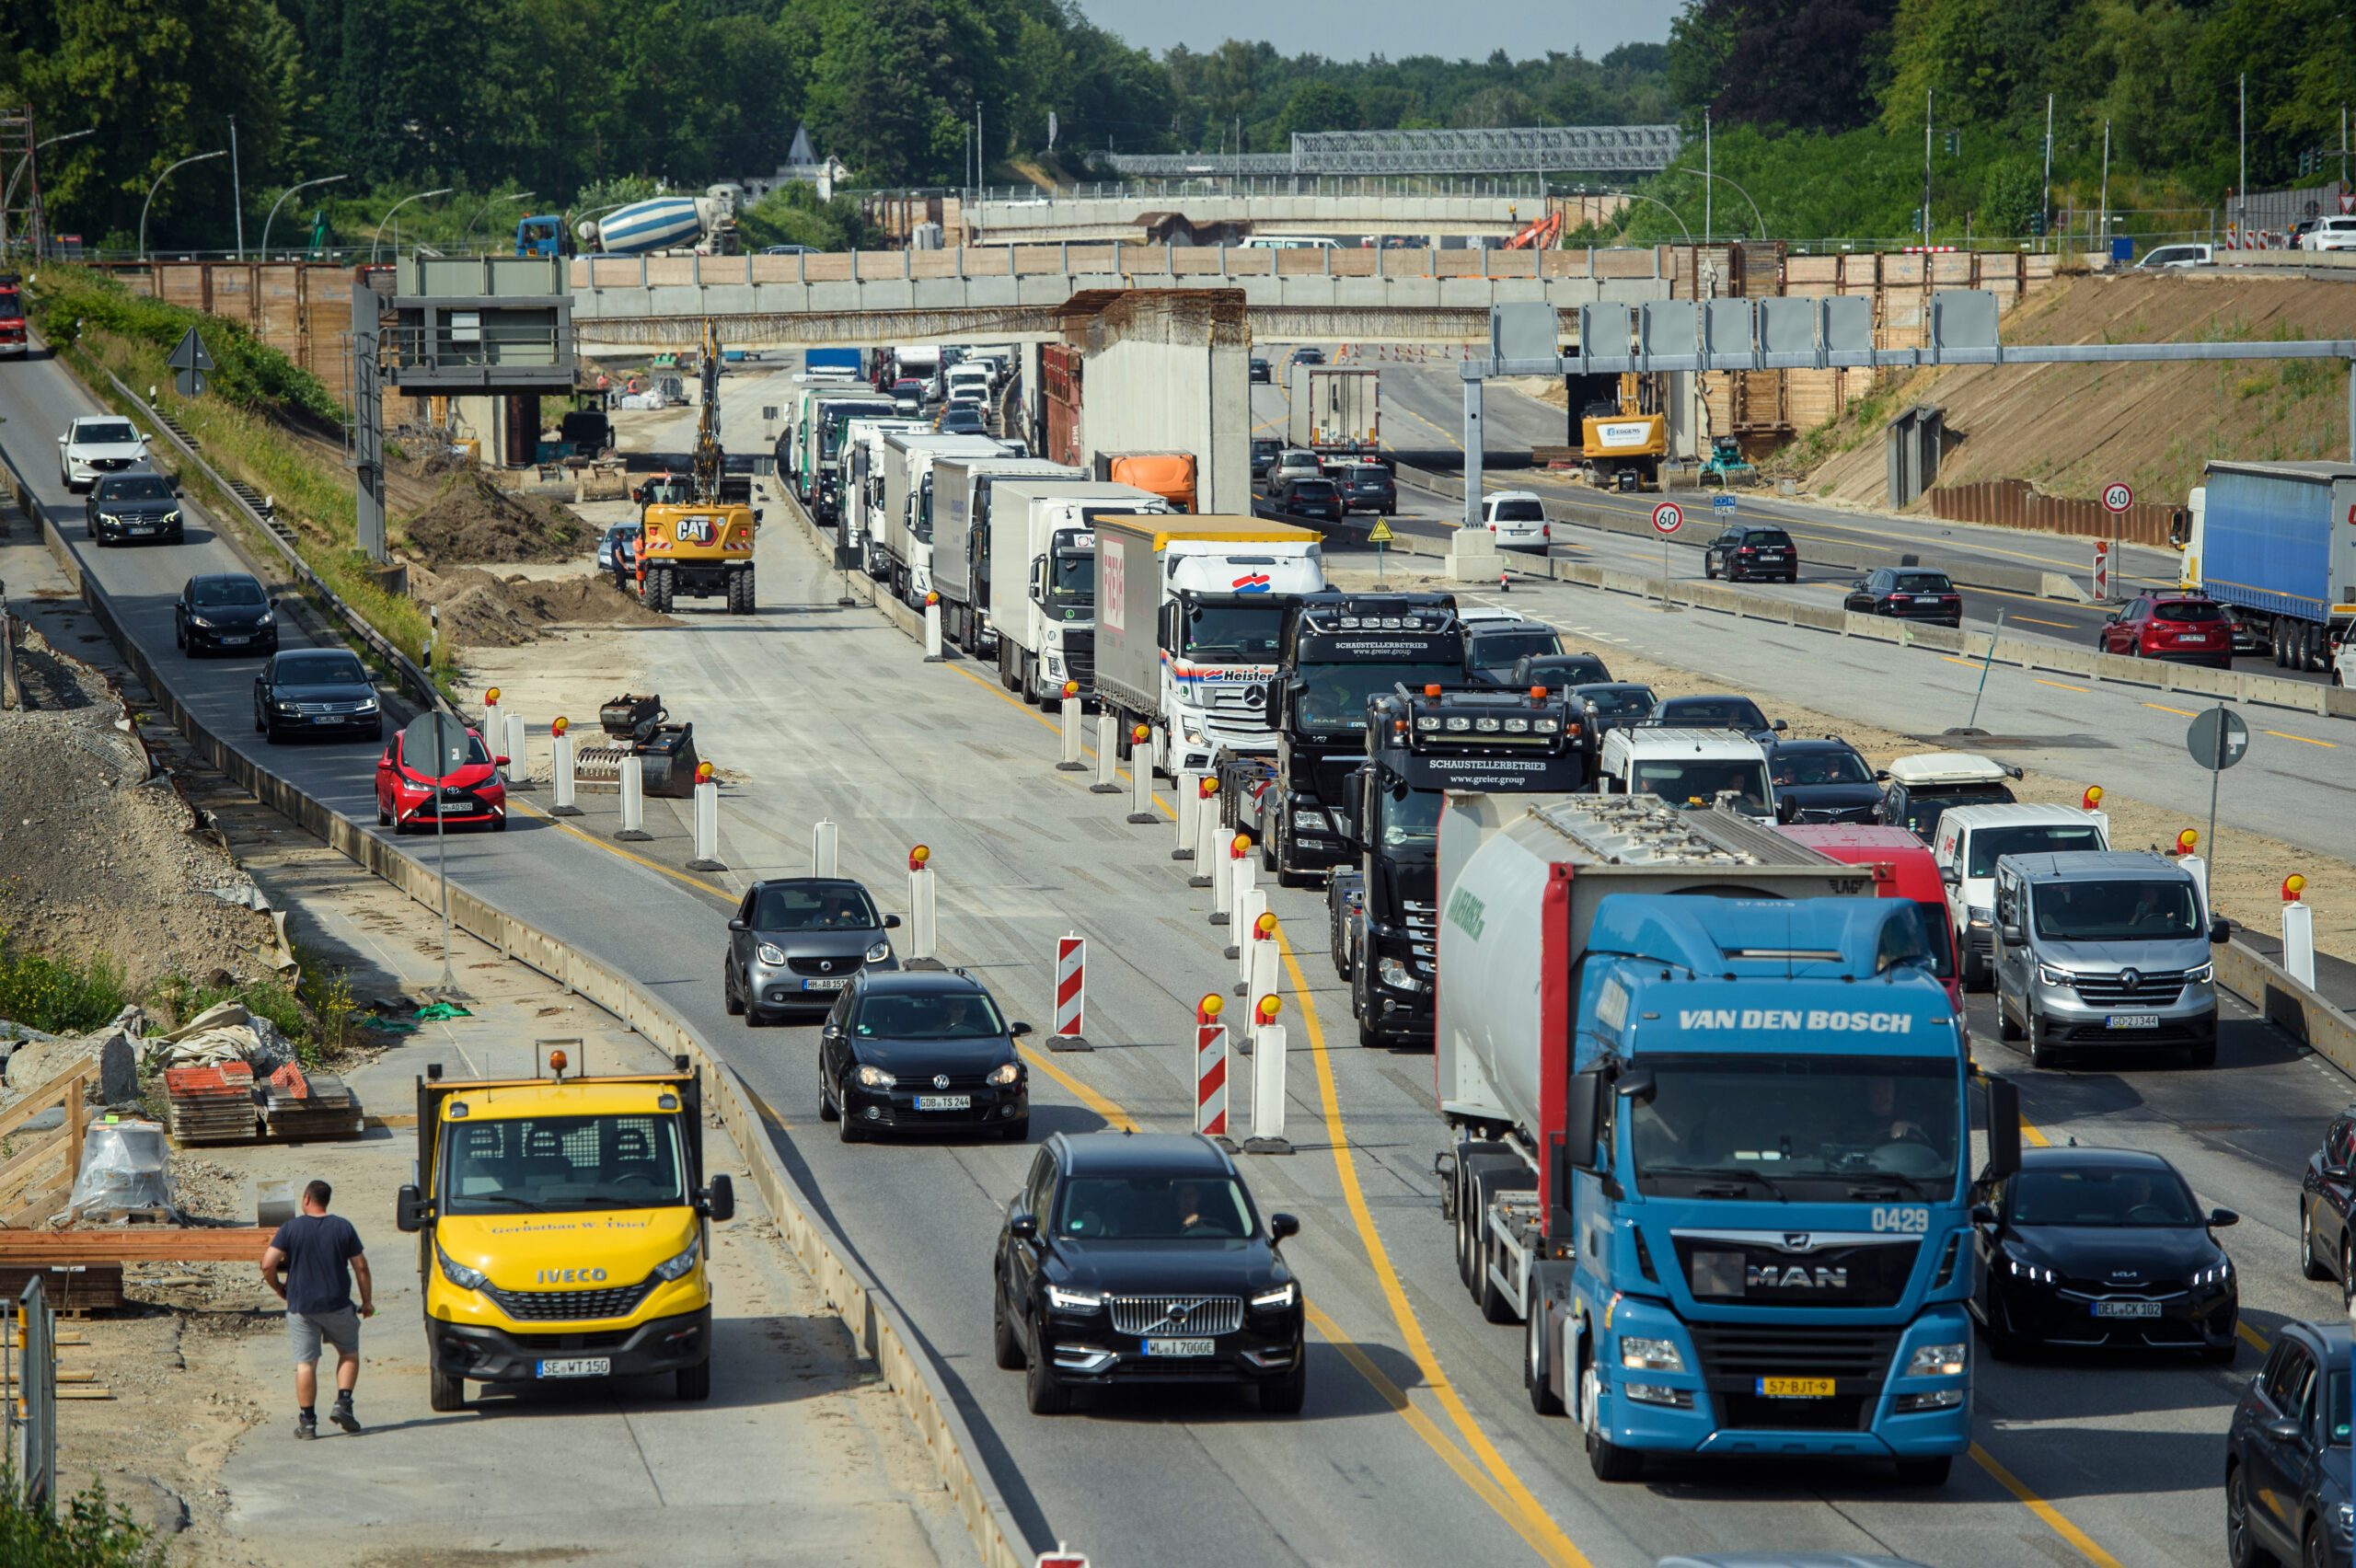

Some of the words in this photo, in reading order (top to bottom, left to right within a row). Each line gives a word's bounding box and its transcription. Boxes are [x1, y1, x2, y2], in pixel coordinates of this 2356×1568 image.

[2108, 490, 2127, 505] 60
[1658, 511, 1677, 525] 60
[676, 521, 709, 541] CAT
[1429, 759, 1546, 771] SCHAUSTELLERBETRIEB
[1449, 775, 1526, 786] www.greier.group
[807, 980, 817, 988] HH
[822, 980, 831, 988] AB
[1680, 1009, 1737, 1030] VAN
[1741, 1009, 1802, 1030] DEN
[1806, 1010, 1912, 1034] BOSCH
[920, 1098, 936, 1108] GDB
[942, 1098, 953, 1107] TS
[954, 1097, 969, 1107] 244
[604, 1221, 646, 1229] Thiel
[1871, 1207, 1929, 1233] 0429
[537, 1267, 607, 1284] IVECO
[1747, 1264, 1847, 1288] MAN
[2098, 1303, 2118, 1315] DEL
[2125, 1303, 2139, 1315] CK
[2142, 1303, 2160, 1315] 102
[1149, 1342, 1163, 1355] WL
[1171, 1342, 1178, 1355] I
[1180, 1342, 1213, 1355] 7000E
[544, 1362, 560, 1374] SE
[567, 1361, 583, 1373] WT
[586, 1360, 608, 1372] 150
[1769, 1380, 1829, 1393] 57-BJT-9
